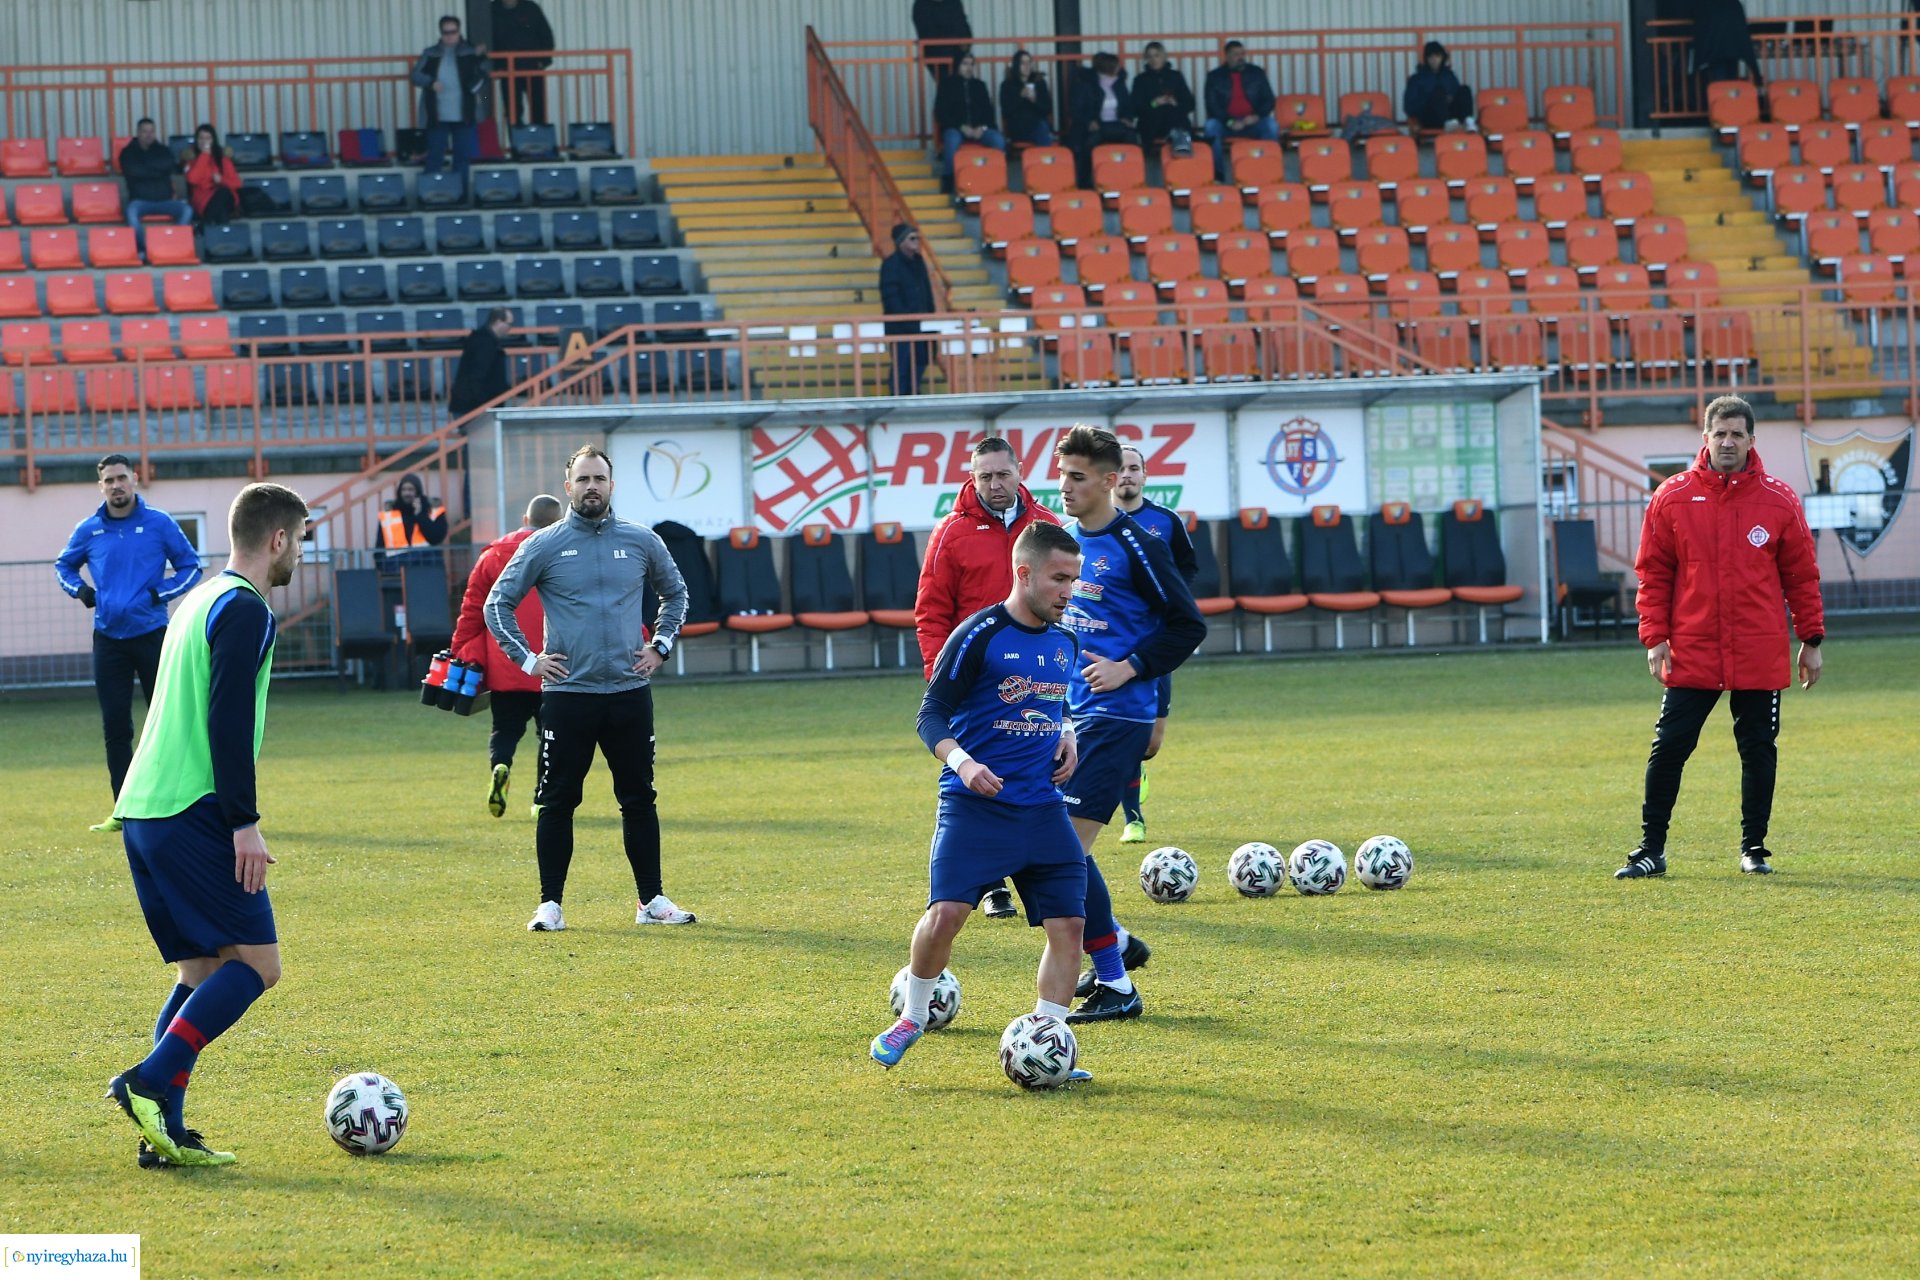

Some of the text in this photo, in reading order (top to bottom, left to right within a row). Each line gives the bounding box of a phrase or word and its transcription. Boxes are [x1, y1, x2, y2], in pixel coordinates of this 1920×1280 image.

[560, 549, 578, 557] JAKO
[1003, 652, 1020, 660] JAKO
[1037, 654, 1045, 667] 11
